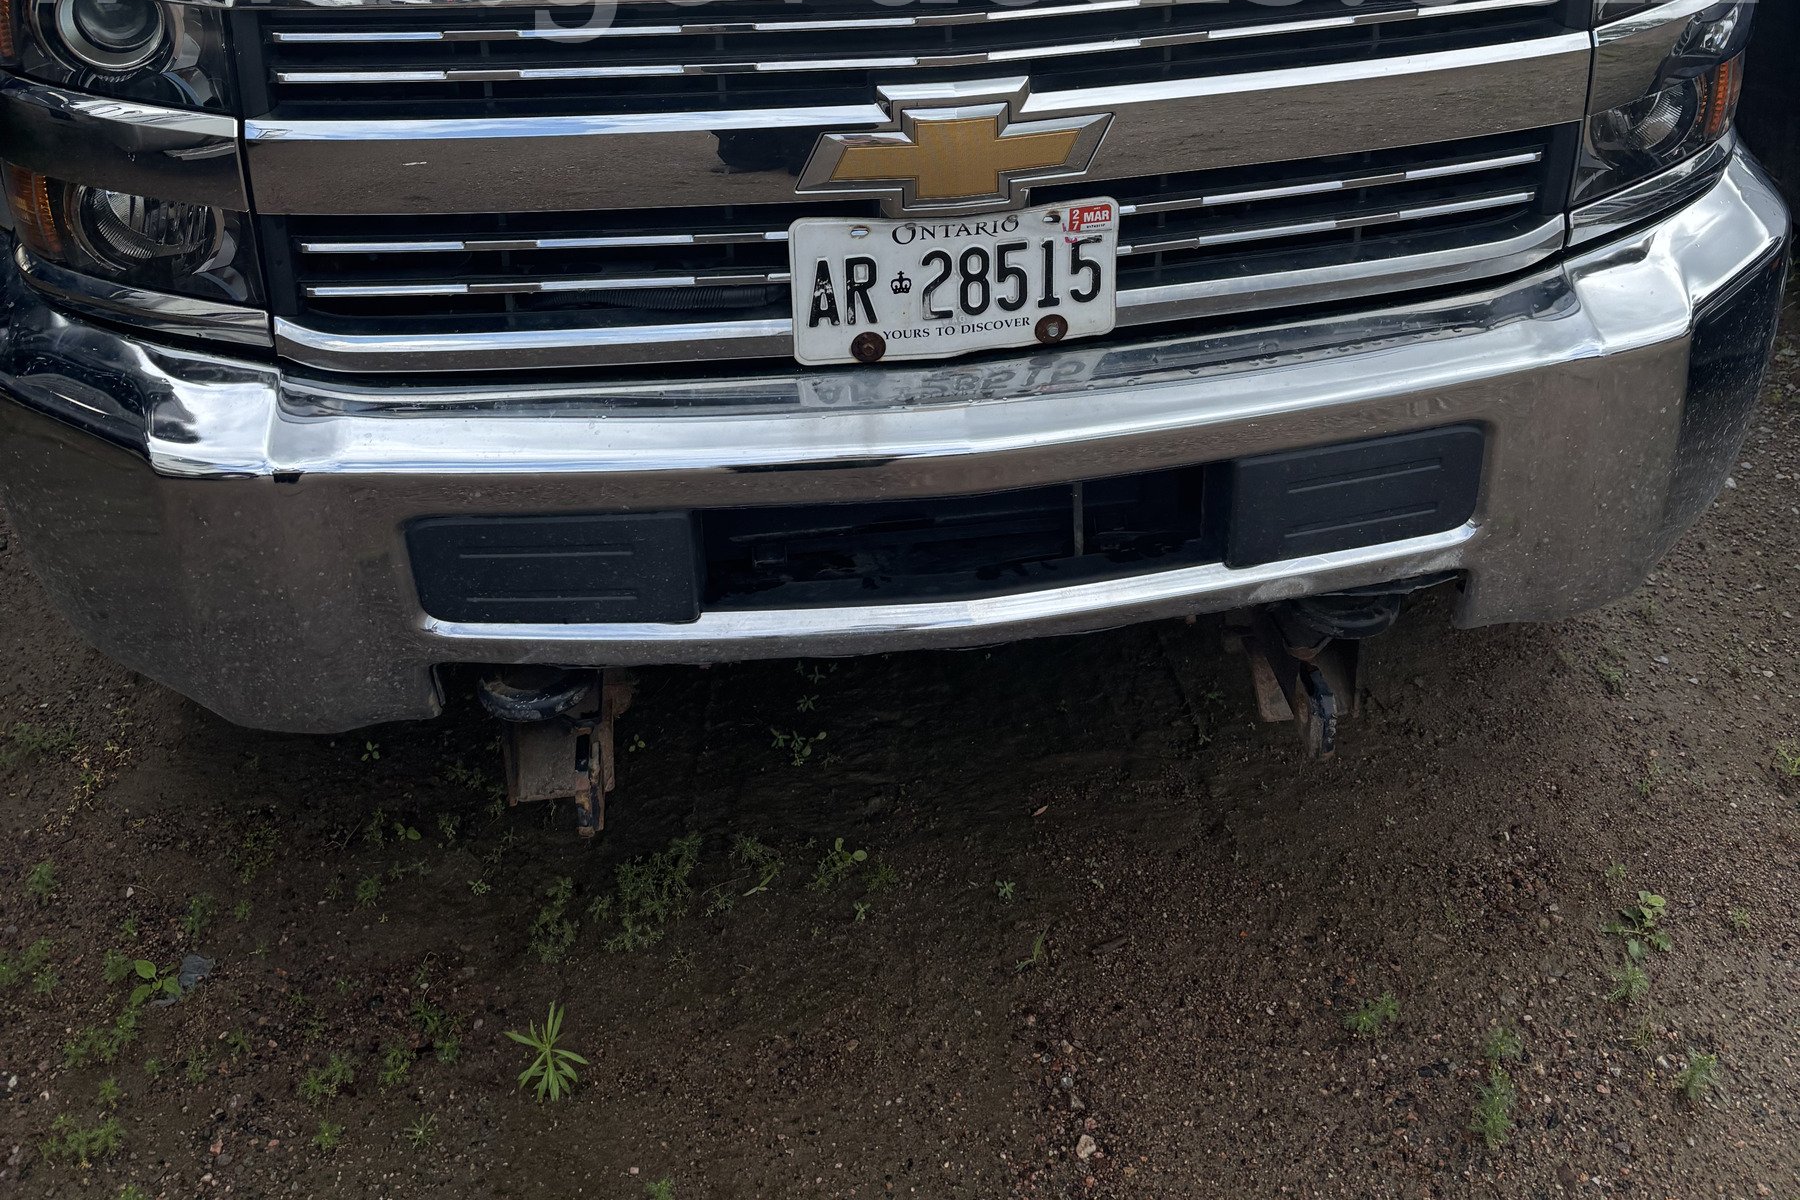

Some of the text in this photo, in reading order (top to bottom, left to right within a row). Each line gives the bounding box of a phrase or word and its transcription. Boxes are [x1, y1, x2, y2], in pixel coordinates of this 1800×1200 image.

[892, 215, 1019, 245] ONTARIO
[1083, 210, 1110, 223] MAR
[808, 235, 1102, 328] AR 28515
[883, 329, 930, 340] YOURS
[936, 326, 955, 337] TO
[961, 316, 1031, 334] DISCOVER
